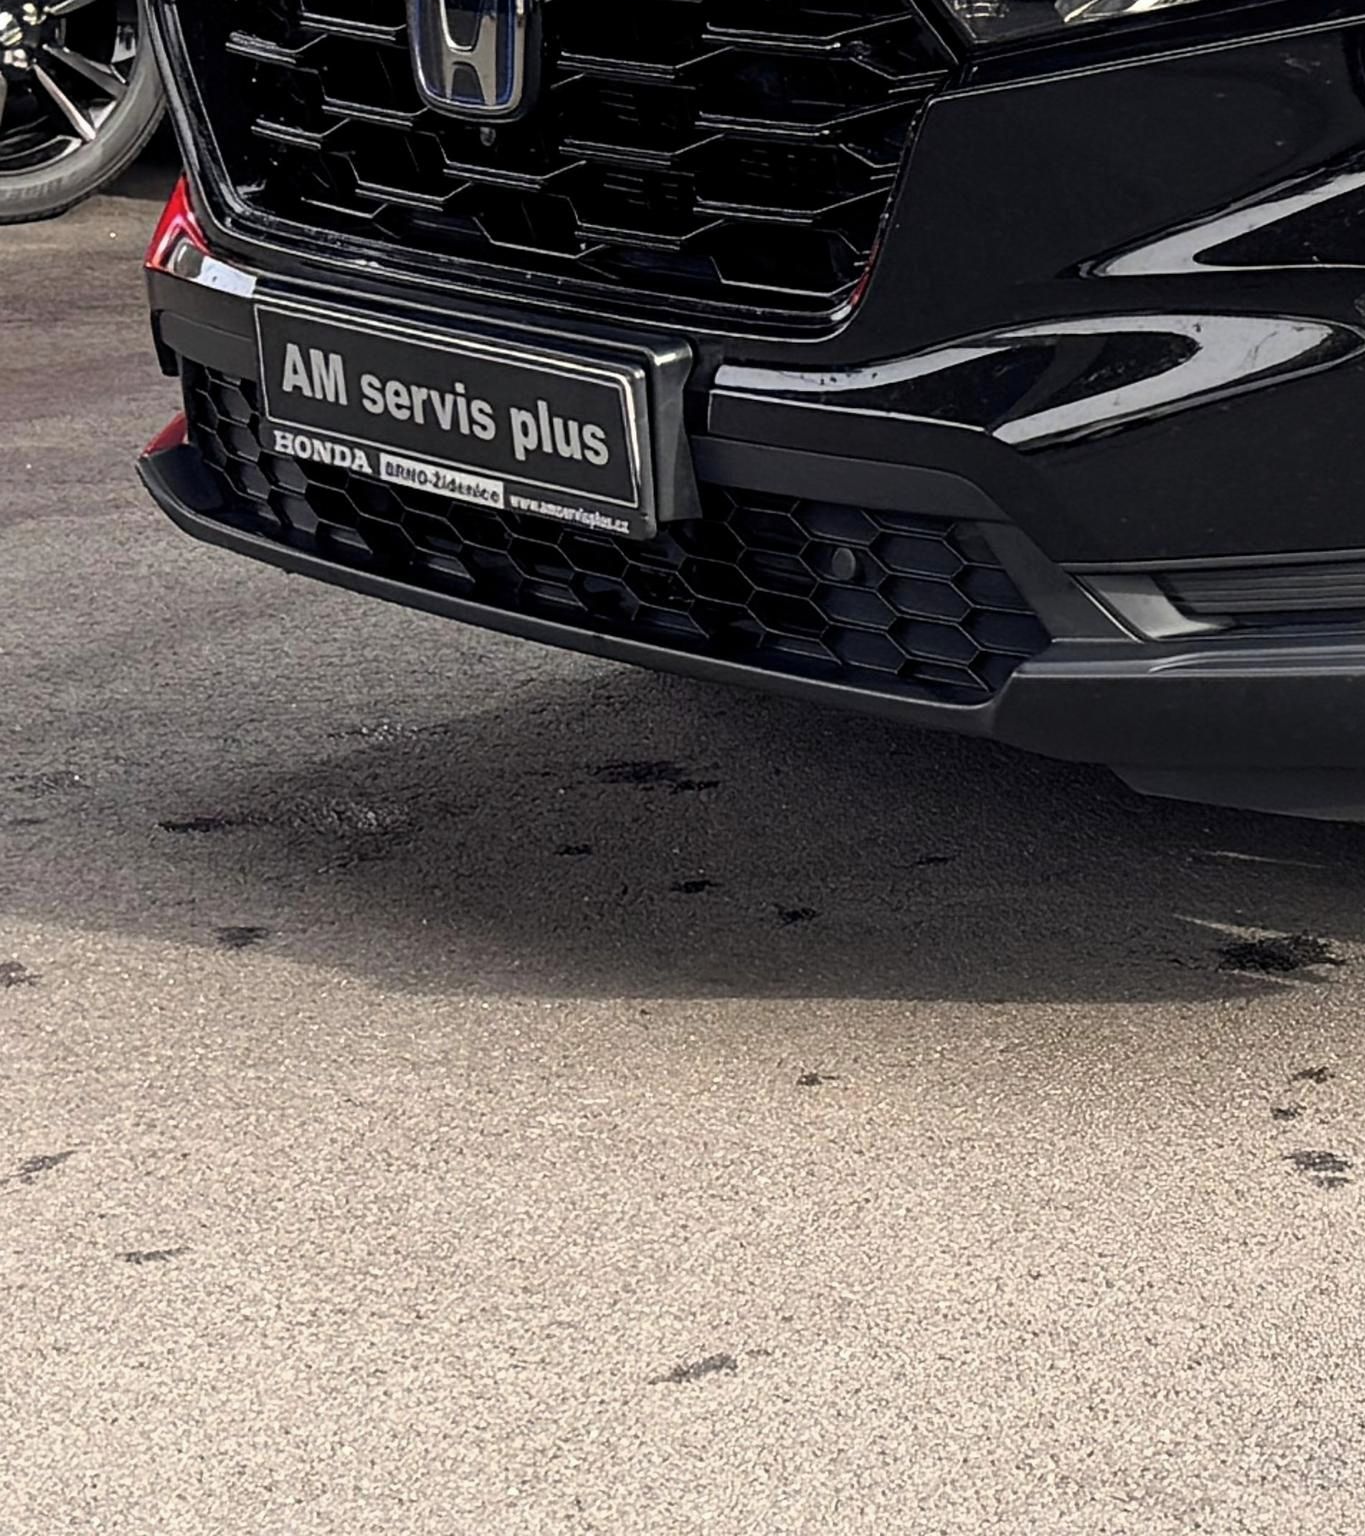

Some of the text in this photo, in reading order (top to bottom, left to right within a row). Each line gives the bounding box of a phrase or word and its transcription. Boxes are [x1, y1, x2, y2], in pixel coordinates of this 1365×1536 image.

[282, 343, 609, 466] AM servis plus
[273, 429, 373, 475] HONDA
